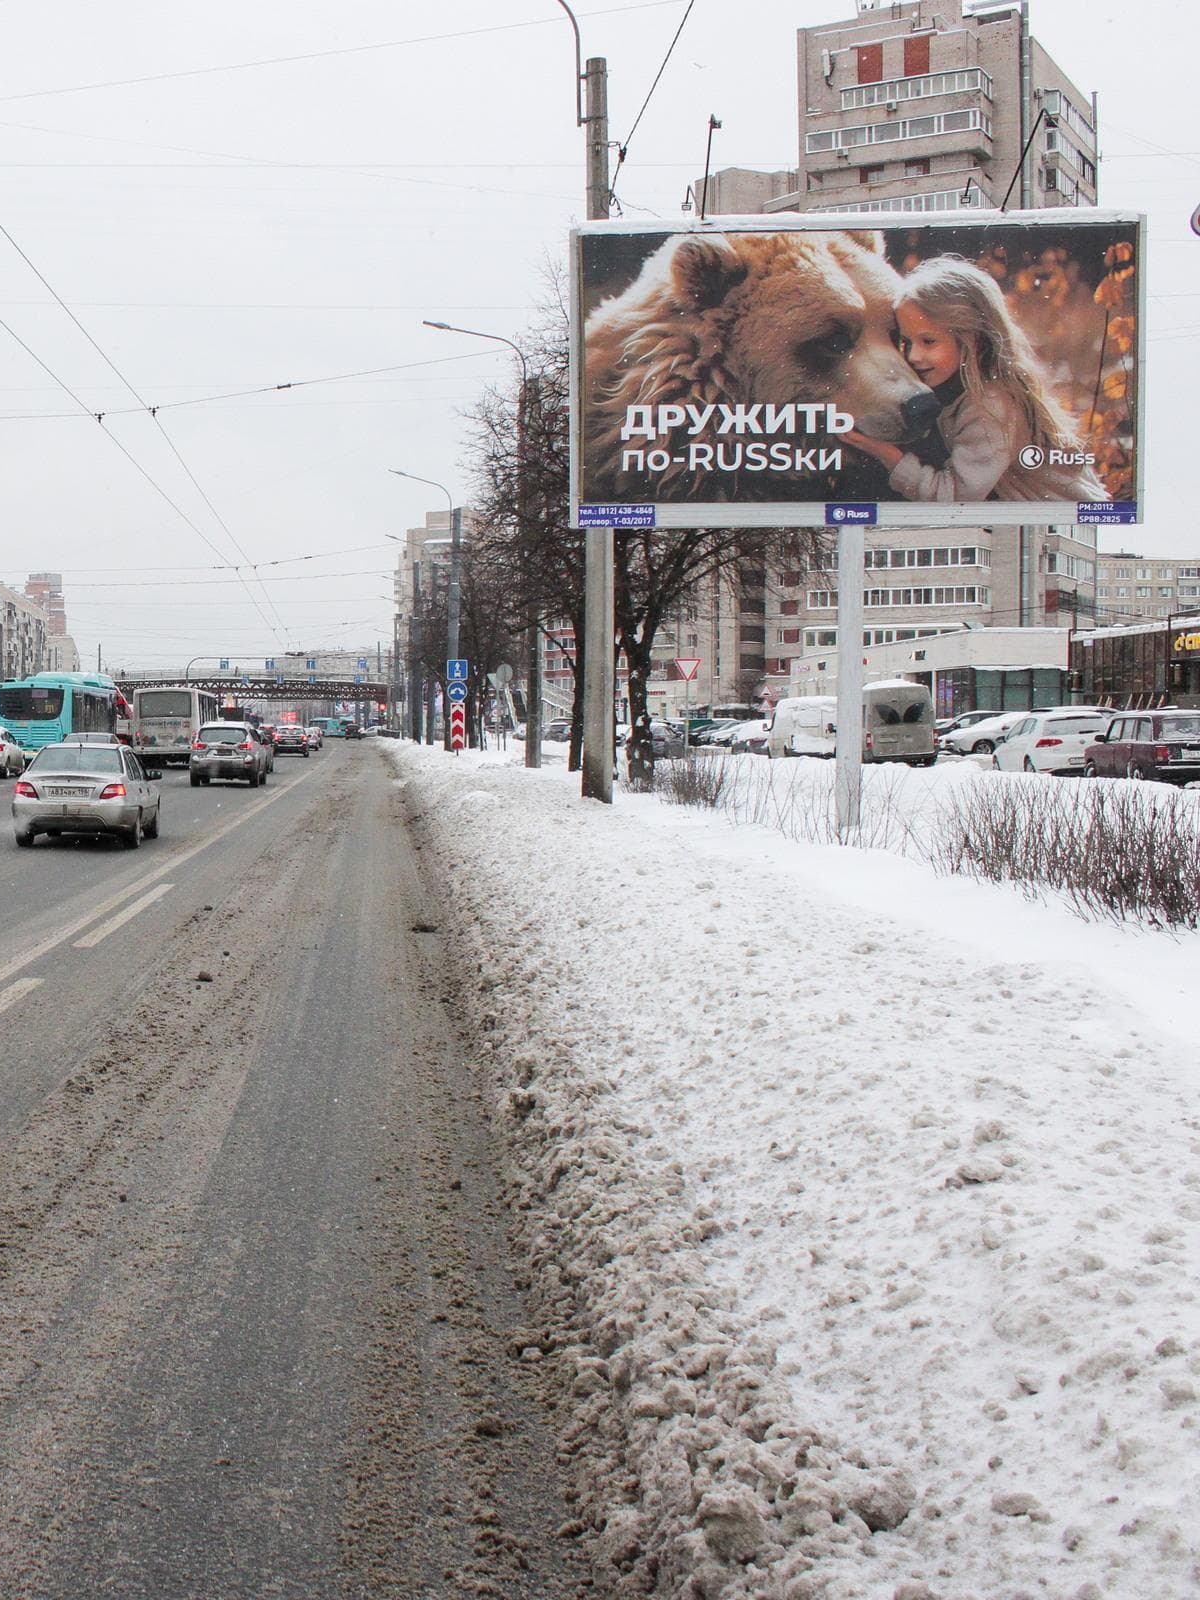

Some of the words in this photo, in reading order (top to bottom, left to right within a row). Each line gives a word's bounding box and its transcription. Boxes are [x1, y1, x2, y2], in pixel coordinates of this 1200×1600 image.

[620, 403, 855, 441] ДРУЖИТЬ
[622, 442, 842, 472] по-RUSSки
[1049, 449, 1096, 465] Russ
[598, 506, 617, 515] (812)
[847, 510, 869, 518] Russ
